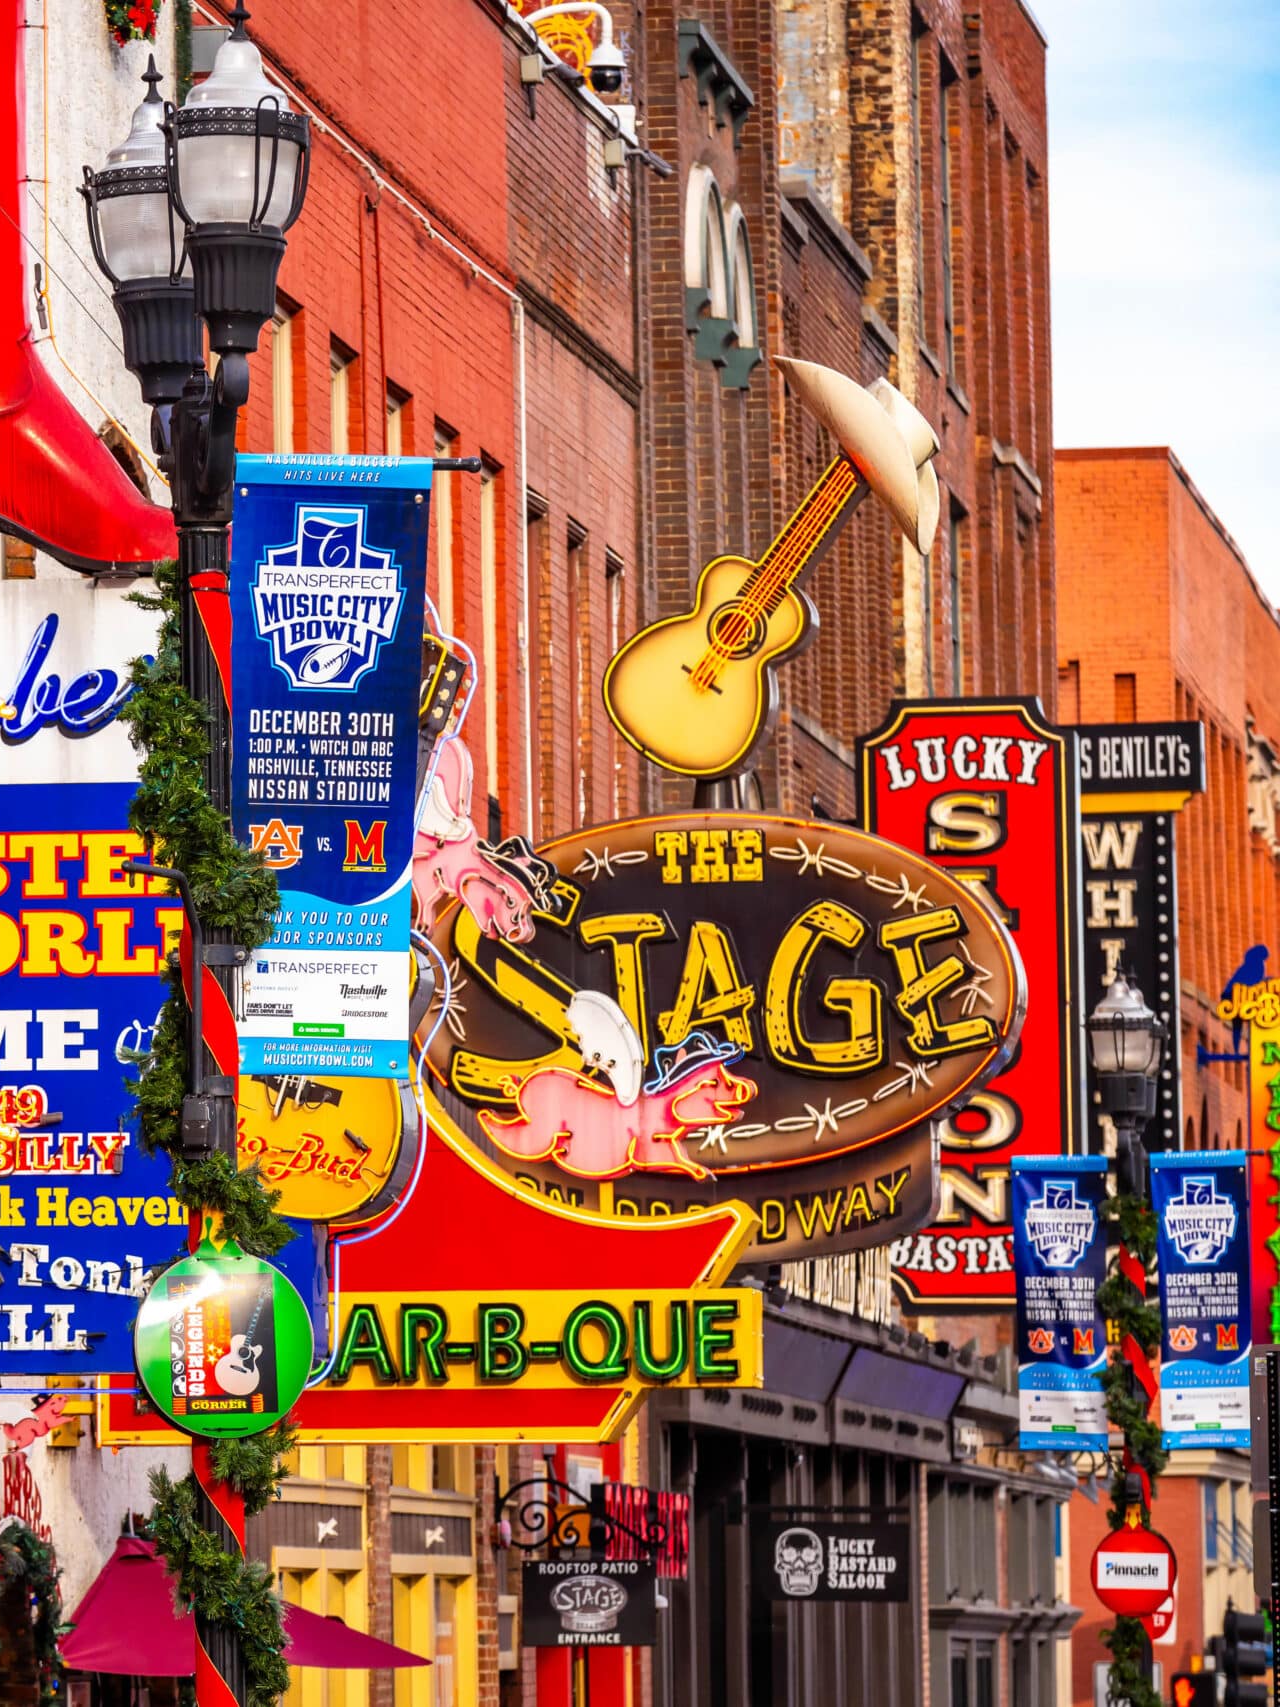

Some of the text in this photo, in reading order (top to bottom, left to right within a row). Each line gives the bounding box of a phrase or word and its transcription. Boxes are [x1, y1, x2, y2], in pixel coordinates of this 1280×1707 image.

[265, 455, 401, 468] NASHVILLE'S BIGGEST
[283, 470, 381, 483] HITS LIVE HERE
[263, 572, 393, 590] TRANSPERFECT
[260, 593, 395, 629] MUSIC CITY
[290, 619, 361, 646] BOWL
[249, 709, 394, 737] DECEMBER 30TH
[248, 738, 394, 757] 1:00 P.M. WATCH ON ABC
[248, 758, 393, 778] NASHVILLE, TENNESSEE
[879, 735, 1048, 792] LUCKY
[248, 779, 391, 802] NISSAN STADIUM
[316, 837, 333, 852] VS.
[655, 830, 764, 884] THE
[300, 912, 328, 926] YOU
[336, 912, 354, 926] TO
[360, 913, 389, 927] OUR
[307, 932, 383, 946] SPONSORS
[270, 961, 378, 975] TRANSPERFECT
[450, 878, 1001, 1108] STAGE
[263, 1043, 373, 1054] FOR MORE INFORMATION VISIT
[263, 1053, 374, 1067] MUSICCITYBOWL.COM
[1028, 1222, 1092, 1238] MUSIC CITY
[1167, 1218, 1233, 1235] MUSIC CITY
[1042, 1234, 1077, 1247] BOWL
[1183, 1230, 1219, 1243] BOWL
[891, 1232, 1016, 1276] BASTA
[1025, 1276, 1096, 1290] DECEMBER 30TH
[1166, 1272, 1238, 1287] DECEMBER 30TH
[1058, 1310, 1096, 1321] STADIUM
[1201, 1305, 1239, 1318] STADIUM
[330, 1299, 741, 1384] AR-B-QUE
[191, 1399, 248, 1411] CORNER
[828, 1536, 876, 1556] LUCKY
[538, 1562, 639, 1575] ROOFTOP PATIO
[828, 1555, 897, 1573] BASTARD
[1106, 1562, 1160, 1578] Pinnacle
[828, 1571, 887, 1590] SALOON
[555, 1583, 623, 1610] STAGE
[557, 1633, 621, 1645] ENTRANCE
